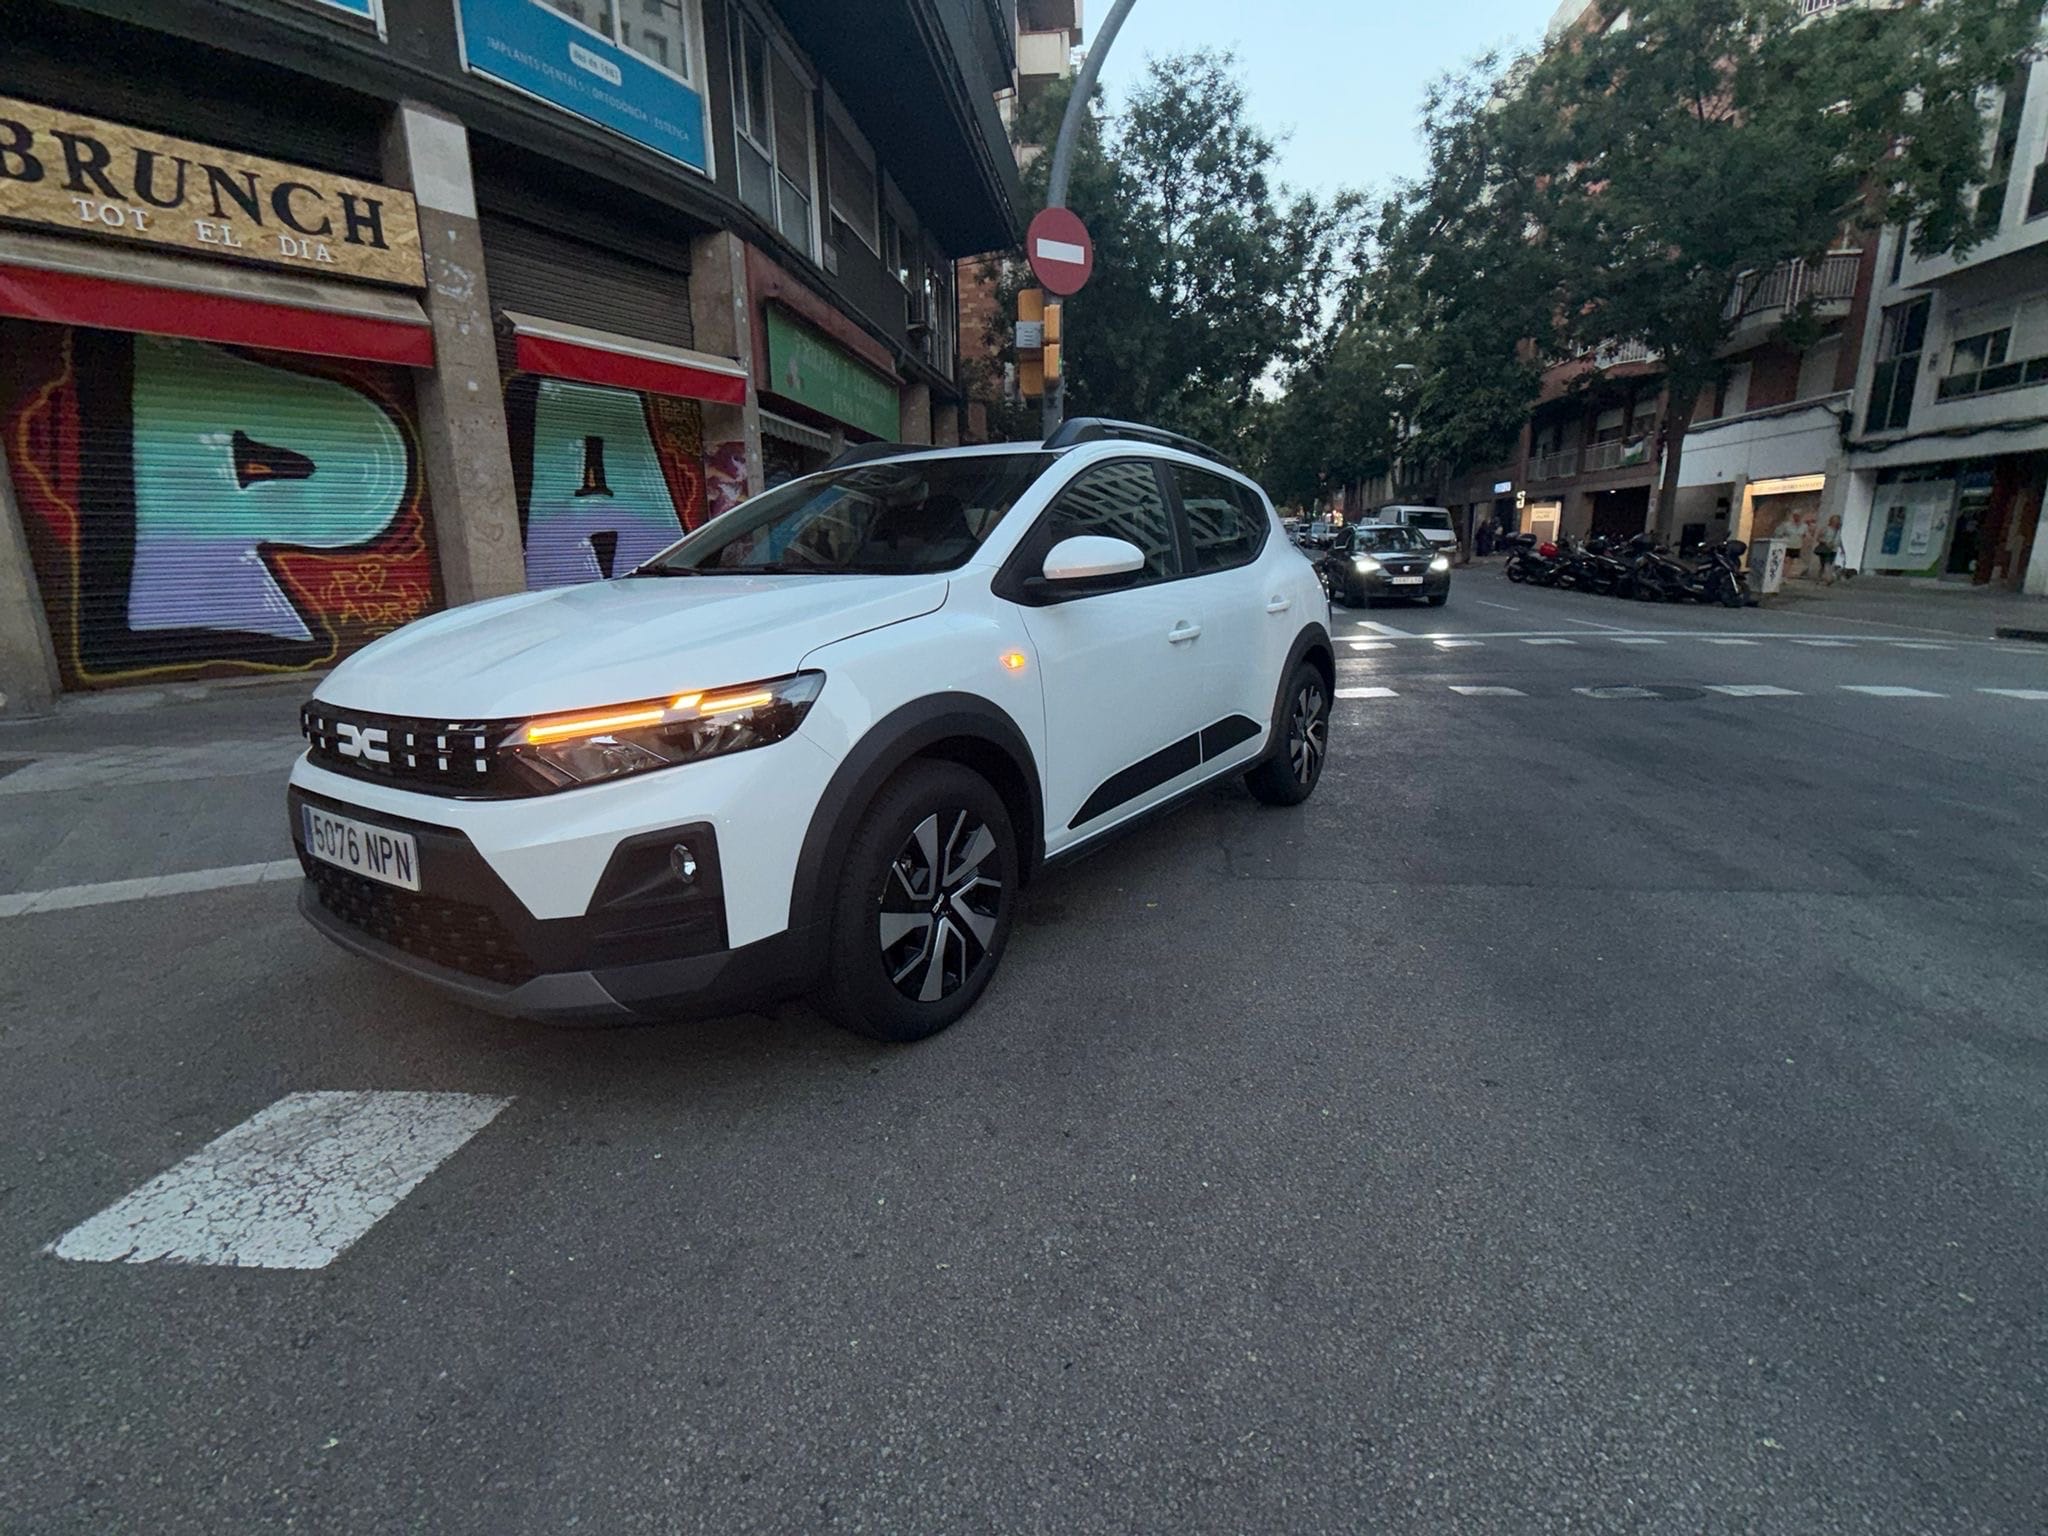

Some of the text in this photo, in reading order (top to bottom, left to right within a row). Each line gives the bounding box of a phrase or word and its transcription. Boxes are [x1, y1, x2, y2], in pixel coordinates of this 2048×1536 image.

[0, 117, 391, 250] BRUNCH
[72, 196, 335, 264] TOT EL DIA
[313, 814, 412, 883] 5076 NPN
